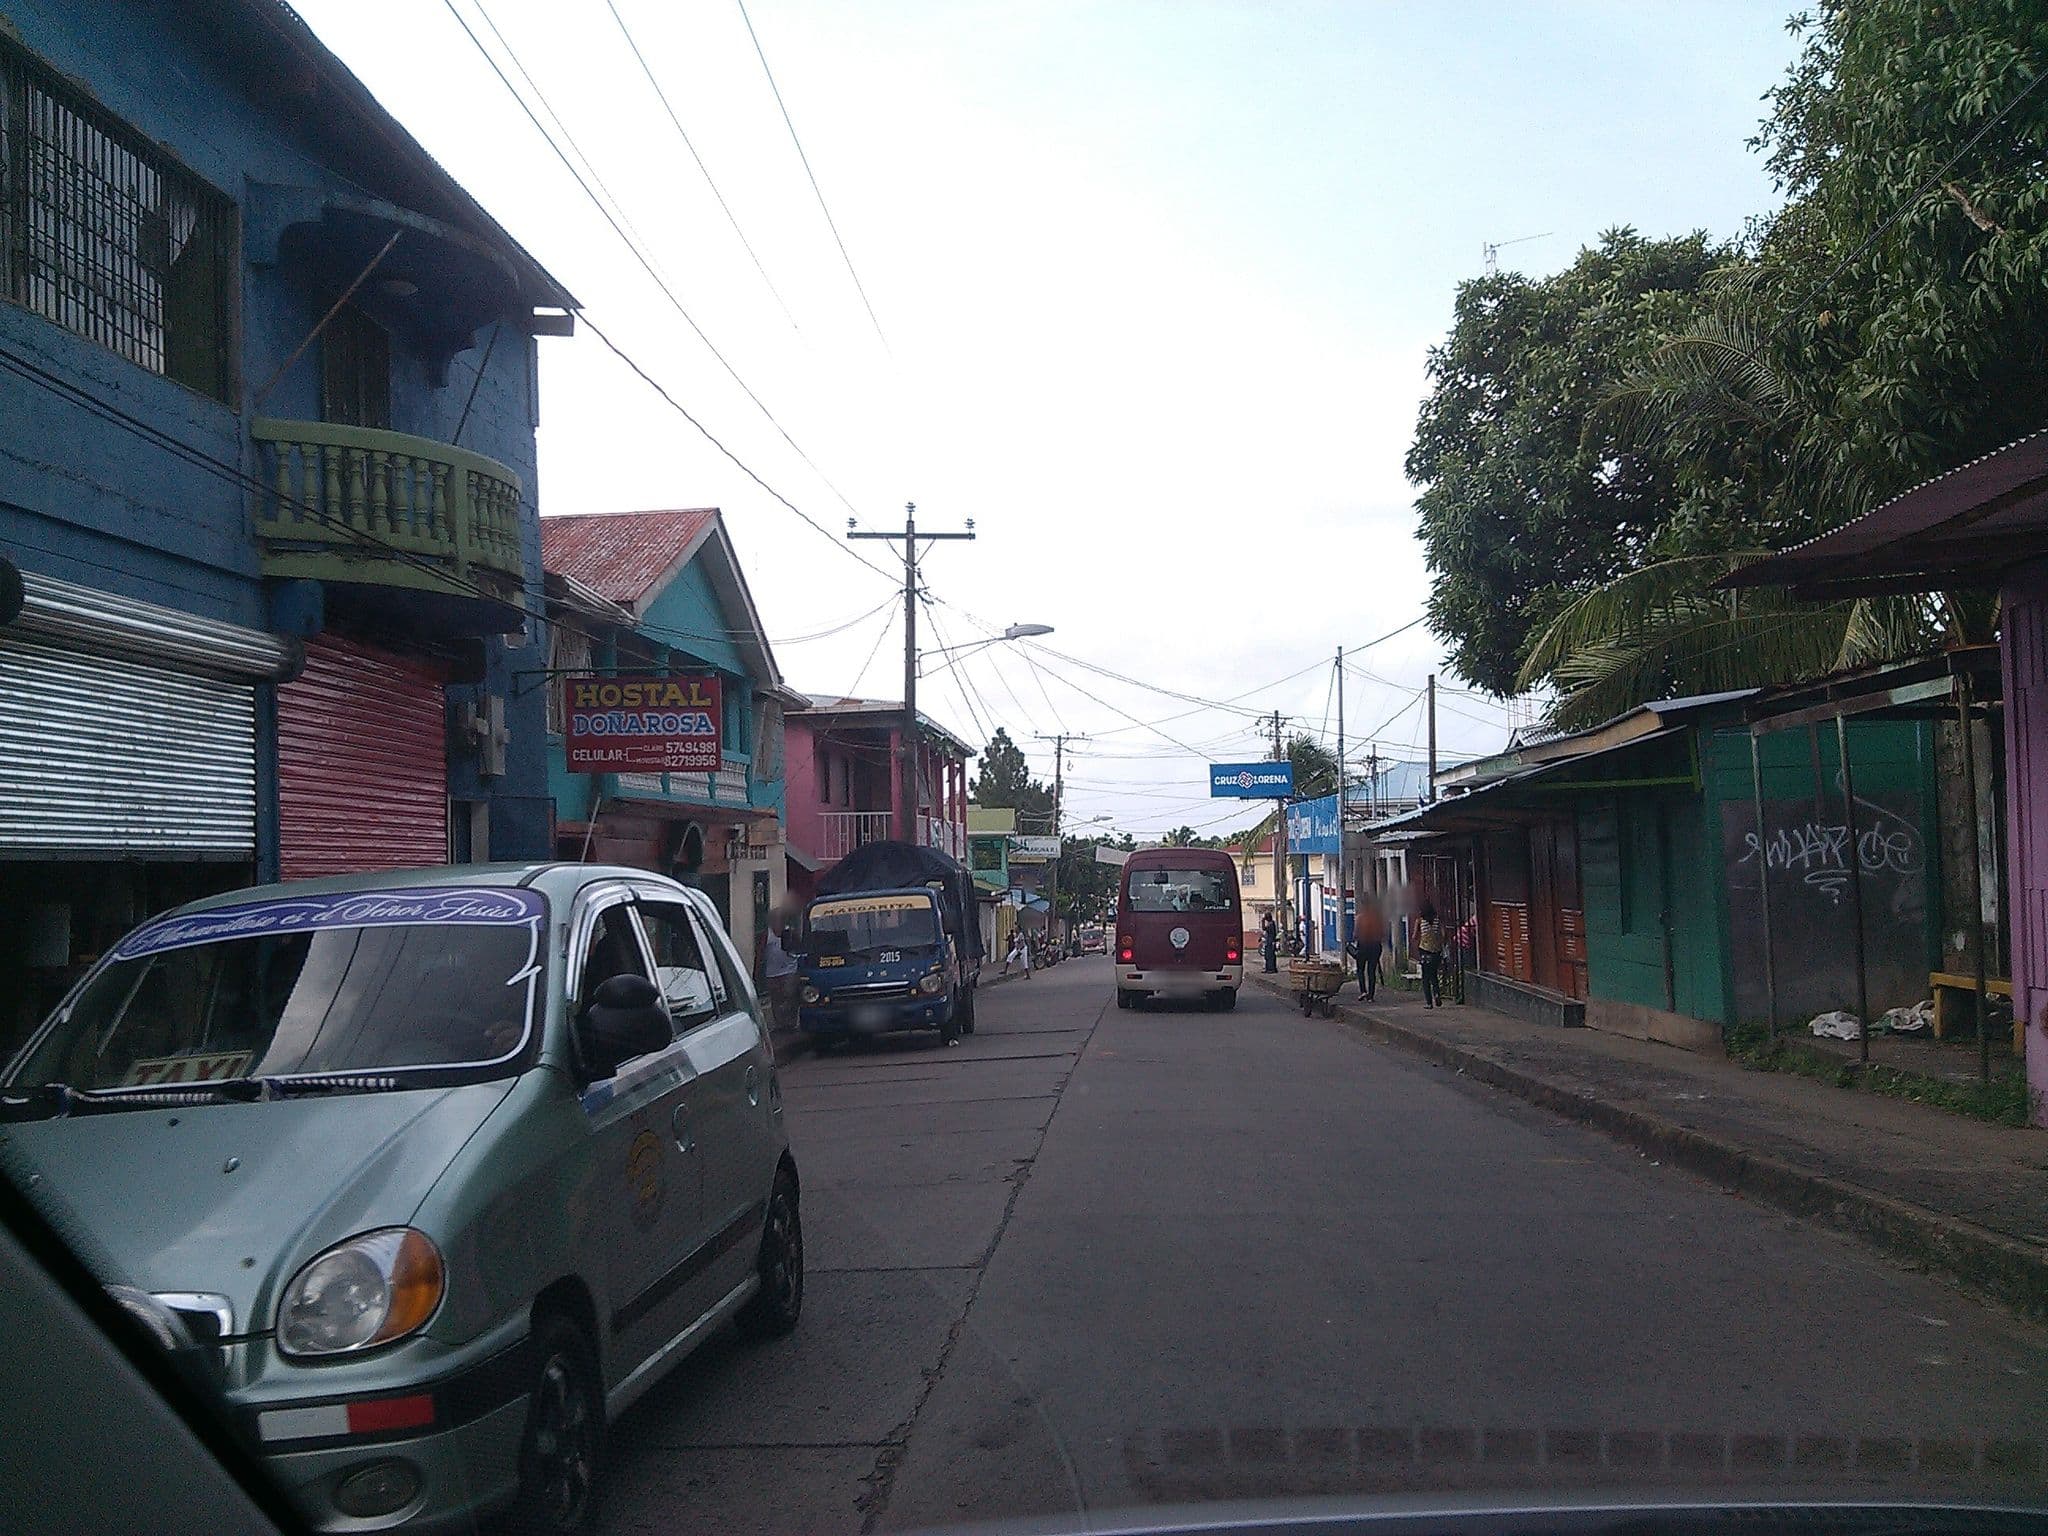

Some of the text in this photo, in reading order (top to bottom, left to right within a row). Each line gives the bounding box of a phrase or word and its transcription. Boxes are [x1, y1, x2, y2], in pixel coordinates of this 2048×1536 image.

[575, 683, 712, 707] HOSTAL
[666, 741, 716, 753] 57494981
[572, 749, 623, 761] CELULAR
[1214, 774, 1288, 786] CRUZ LORENA
[342, 899, 424, 921] Señor
[823, 902, 914, 916] MARGARITA
[880, 951, 901, 963] 2015
